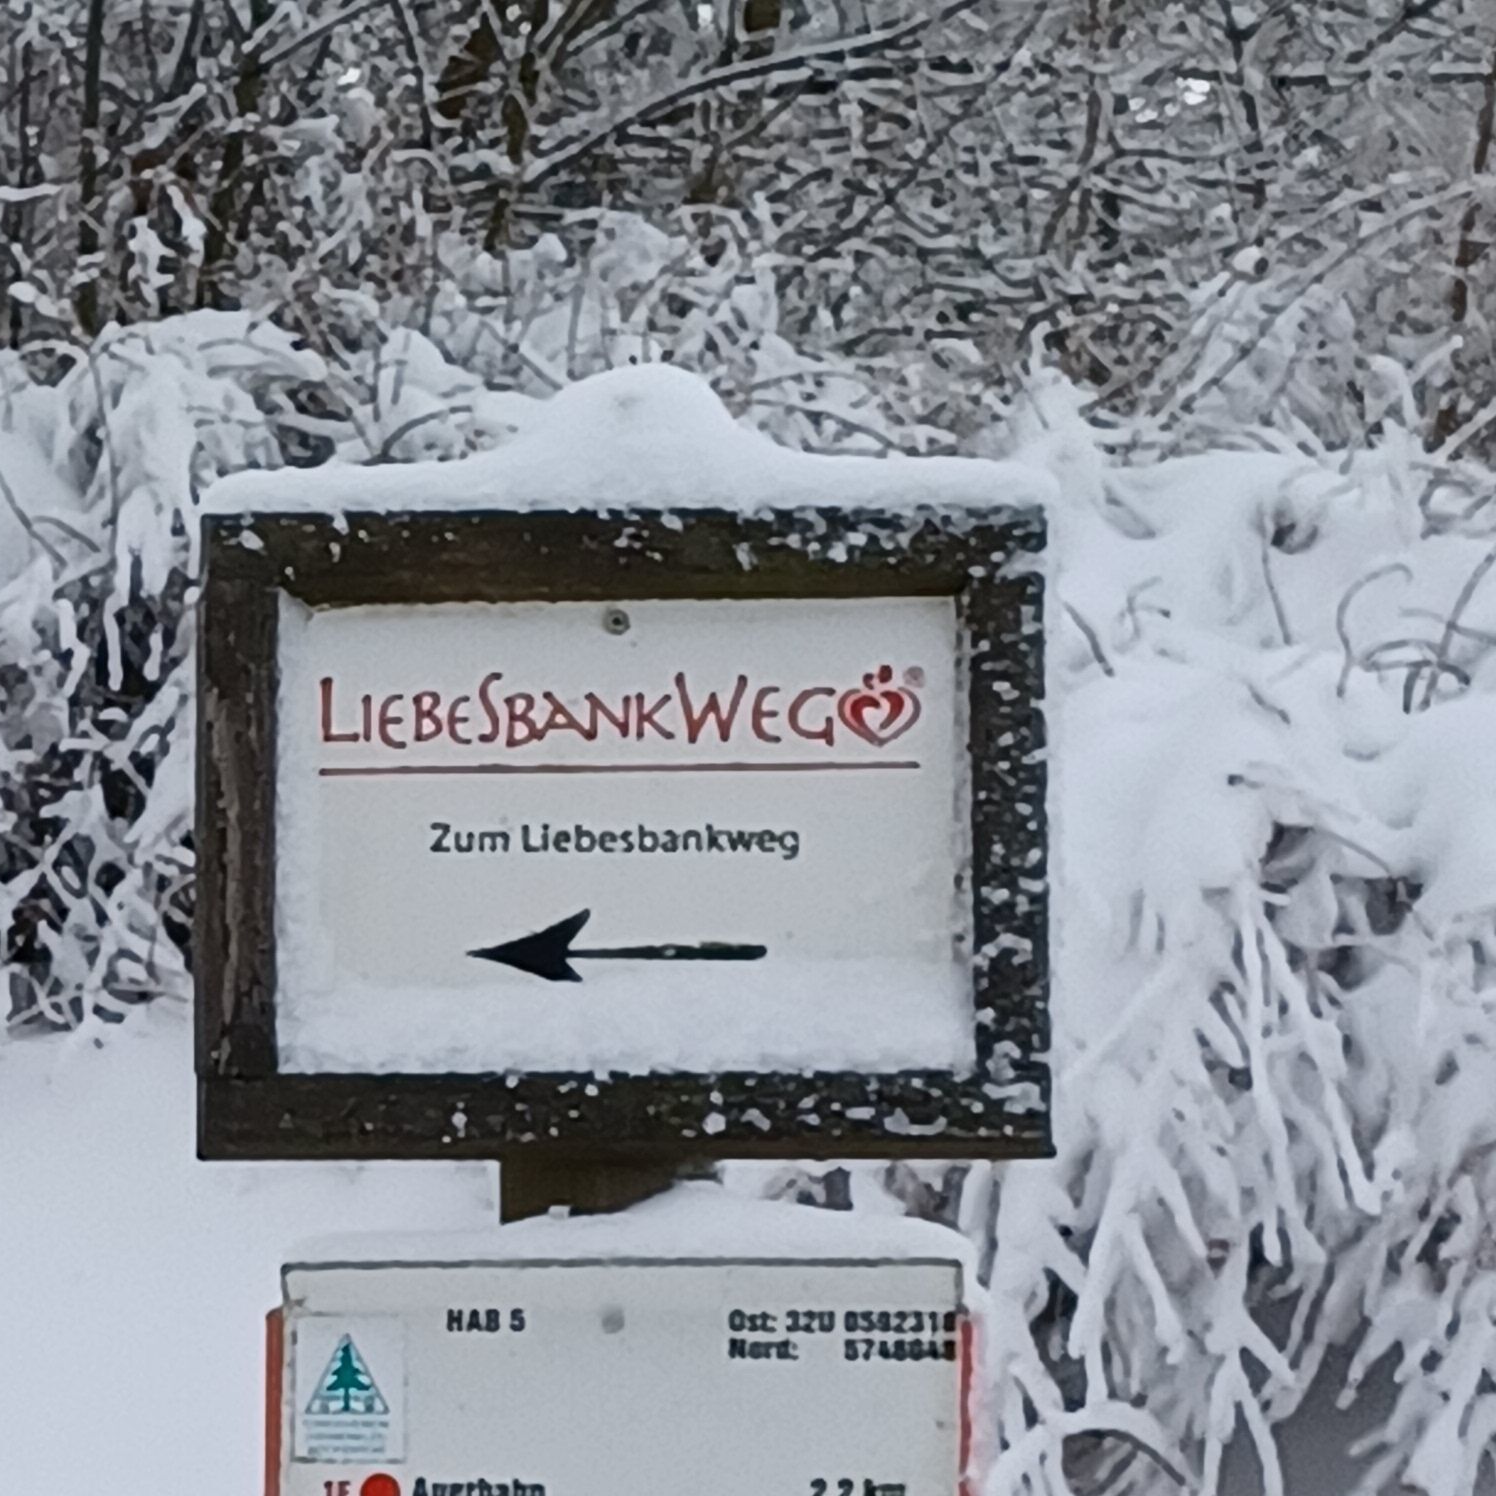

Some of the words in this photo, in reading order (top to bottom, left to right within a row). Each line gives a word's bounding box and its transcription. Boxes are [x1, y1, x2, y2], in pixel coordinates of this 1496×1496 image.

[429, 821, 511, 854] Zum
[521, 822, 800, 861] Liebesbankweg
[446, 1308, 501, 1333] HAB
[509, 1307, 526, 1333] 5
